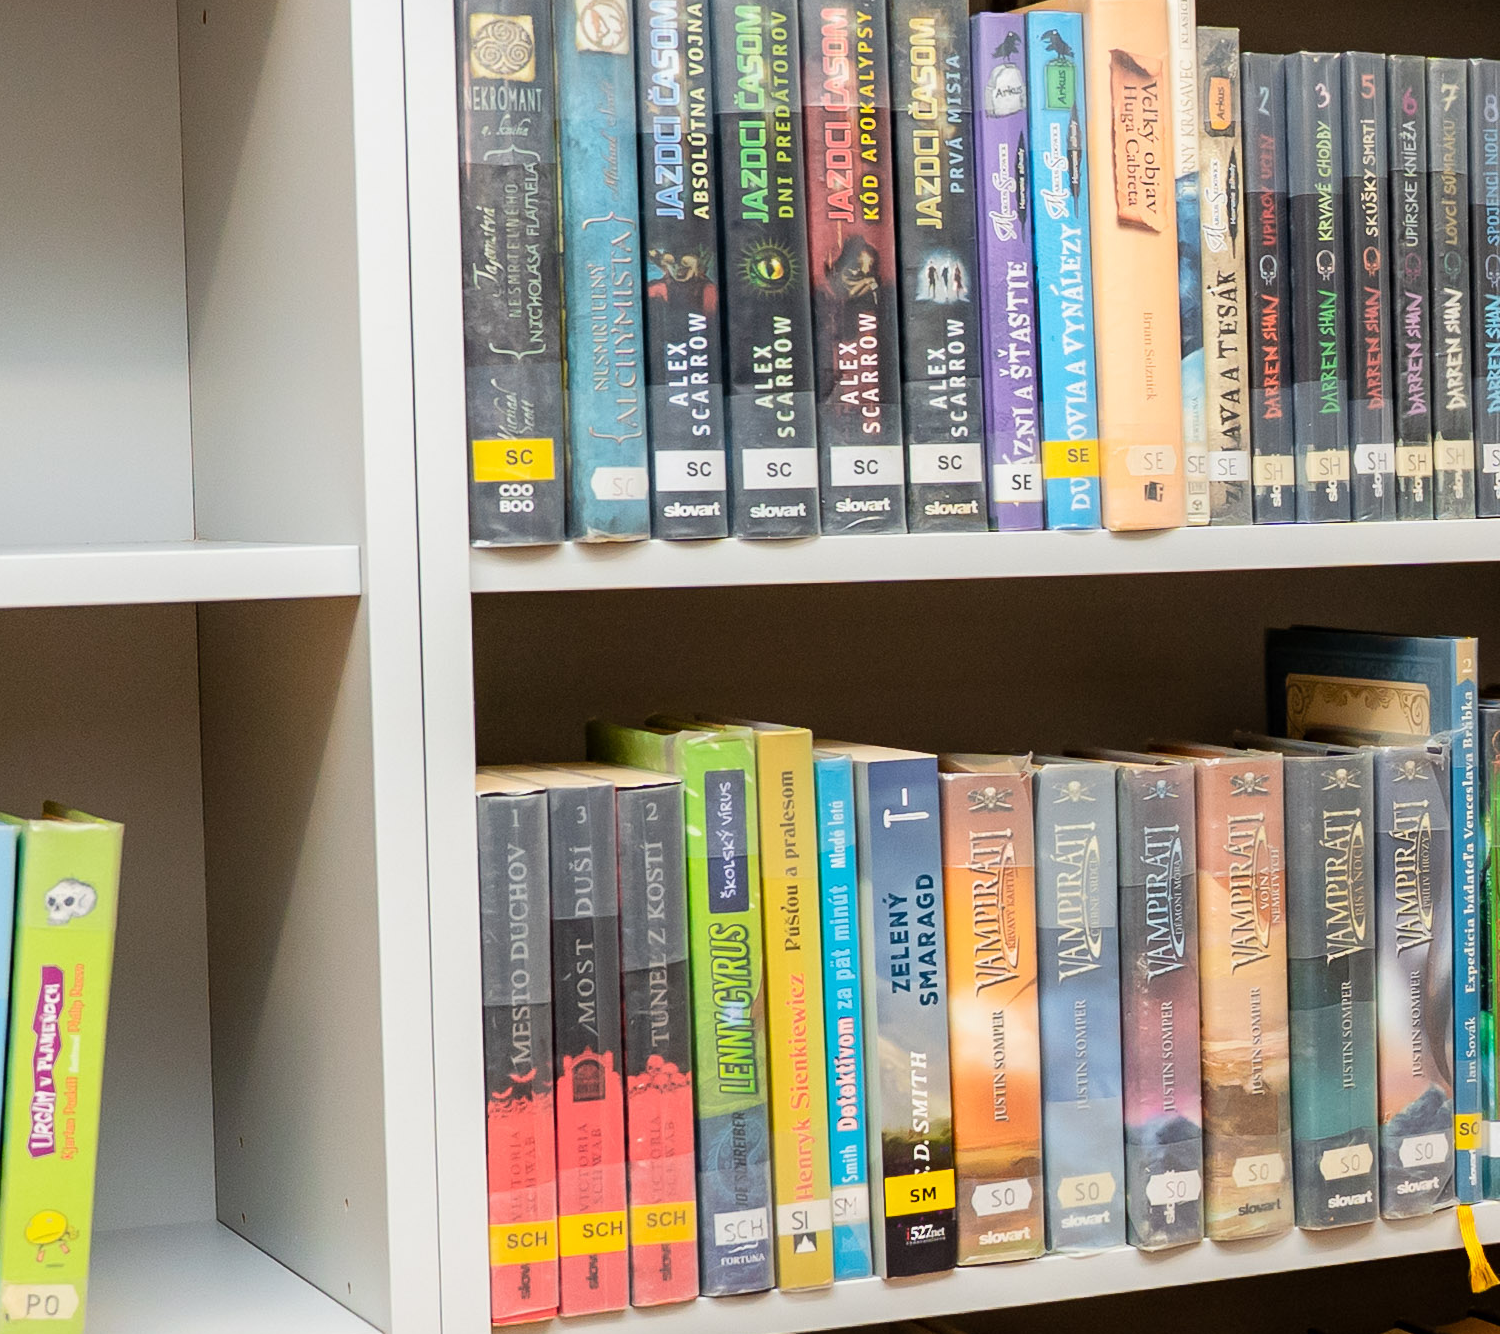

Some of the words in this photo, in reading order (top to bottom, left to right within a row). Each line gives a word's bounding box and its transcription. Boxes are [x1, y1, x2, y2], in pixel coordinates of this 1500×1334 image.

[687, 3, 704, 87] VOJNA
[772, 11, 792, 166] PREDÁTOROV
[857, 11, 879, 163] APOKALYPSY
[948, 53, 960, 125] MISIA
[1139, 80, 1160, 137] Veľký
[654, 119, 686, 220] JAZDCI
[687, 89, 710, 220] ABSOLÚTNA
[949, 136, 964, 192] PRVÁ
[1141, 146, 1162, 216] objav
[1316, 120, 1331, 178] CHODBY
[778, 175, 793, 219] DNI
[862, 174, 881, 222] KÓD
[1318, 179, 1333, 241] KRVAVÉ
[1322, 290, 1338, 337] SHAN
[667, 342, 689, 408] ALEX
[689, 313, 711, 437] SCARROW
[1320, 342, 1338, 415] DARREN
[686, 461, 712, 478] SC
[663, 501, 721, 519] slovart
[720, 781, 733, 825] VÍRUS
[645, 841, 664, 916] KOSTÍ
[719, 830, 737, 898] ŠKOLSKÝ
[509, 846, 528, 954] DUCHOV
[649, 923, 666, 941] Z
[891, 893, 913, 994] ZELENÝ
[916, 874, 939, 1006] SMARAGD
[510, 967, 529, 1071] MESTO
[650, 948, 670, 1045] TUNEL
[789, 973, 810, 1108] Sienkiewicz
[793, 1113, 813, 1201] Henryk
[910, 1185, 937, 1202] SM
[507, 1229, 548, 1249] SCH
[24, 1293, 59, 1316] PO
